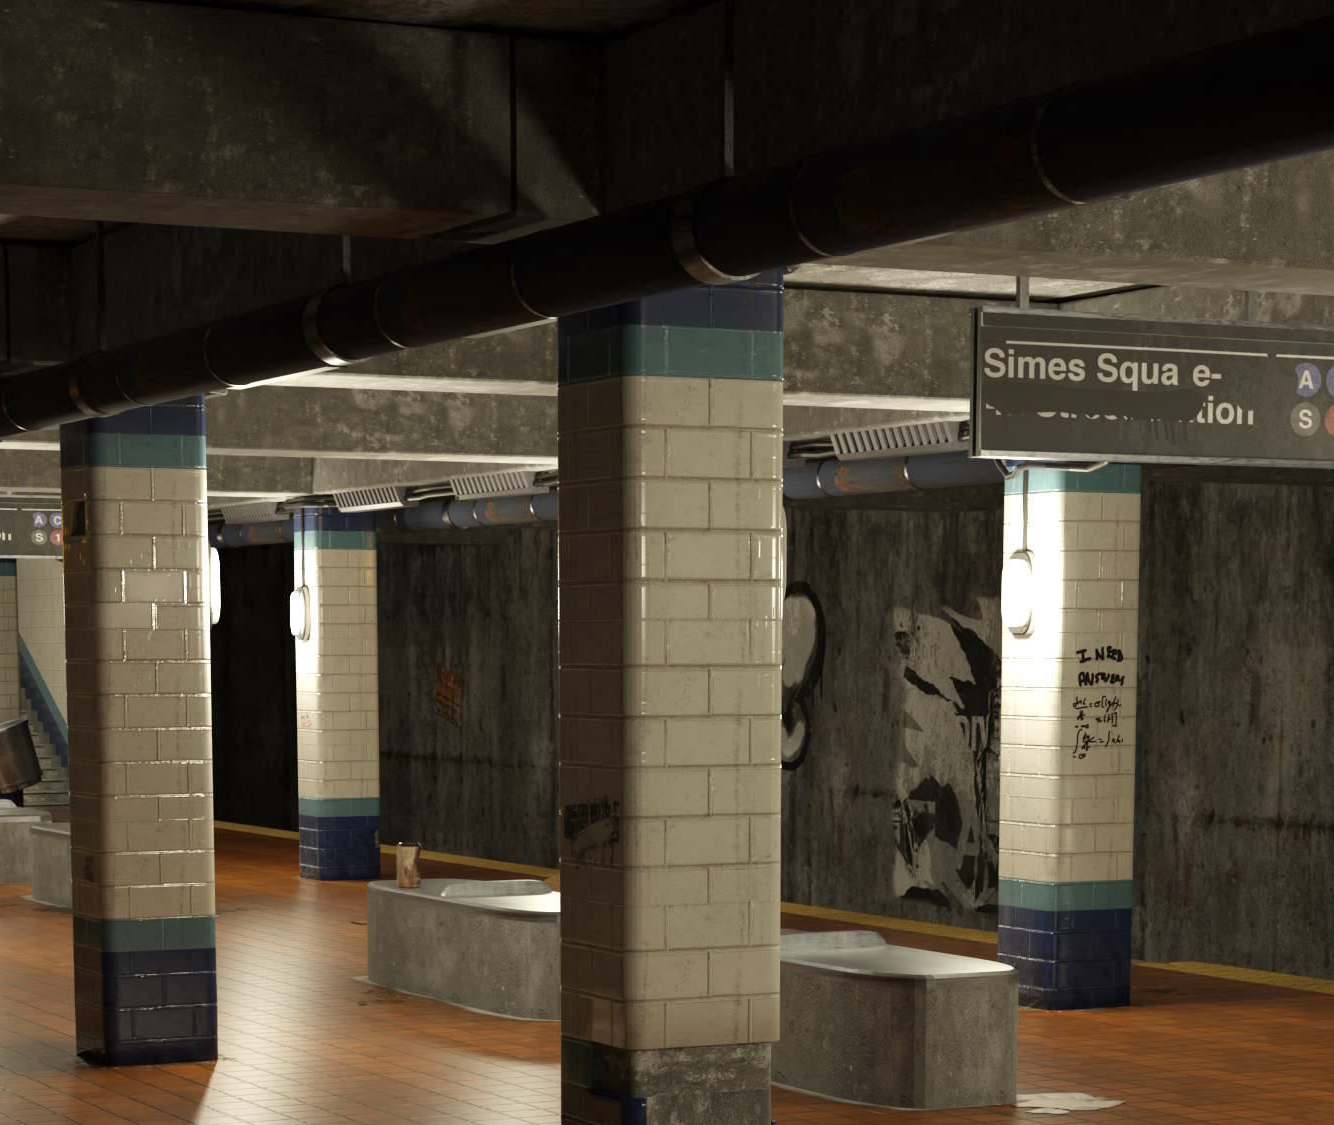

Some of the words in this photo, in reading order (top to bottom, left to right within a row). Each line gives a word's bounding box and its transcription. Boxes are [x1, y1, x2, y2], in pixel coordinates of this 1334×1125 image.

[983, 347, 1086, 381] Simes
[1298, 370, 1314, 390] A
[1298, 409, 1312, 429] S
[34, 515, 44, 525] A
[35, 532, 44, 542] S
[1076, 649, 1092, 663] I
